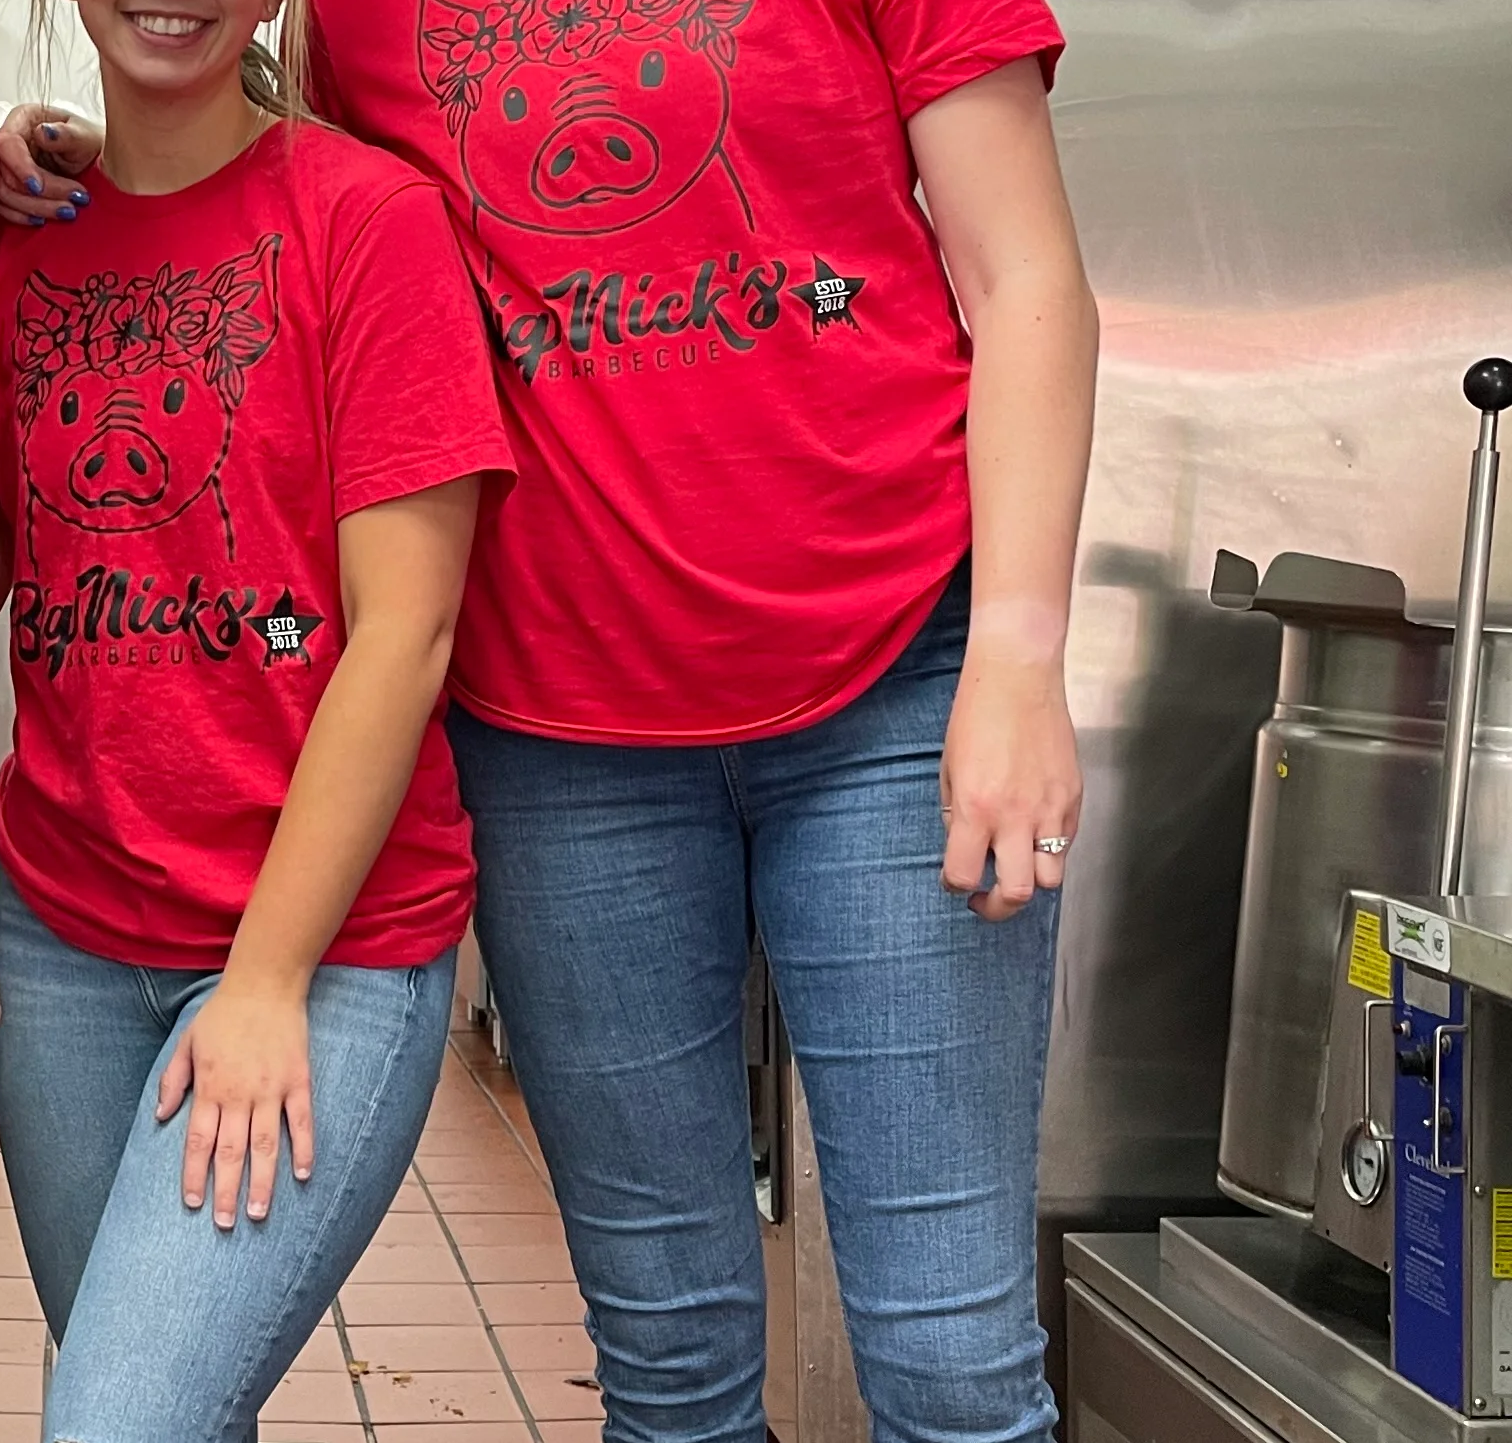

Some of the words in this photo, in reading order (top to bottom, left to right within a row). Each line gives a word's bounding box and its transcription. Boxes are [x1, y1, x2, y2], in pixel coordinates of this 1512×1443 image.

[814, 278, 846, 295] ESTD
[543, 251, 787, 353] Nick's
[817, 296, 846, 314] 2018
[548, 339, 720, 379] BARBECUE
[267, 616, 296, 632] ESTD
[270, 635, 299, 650] 2018
